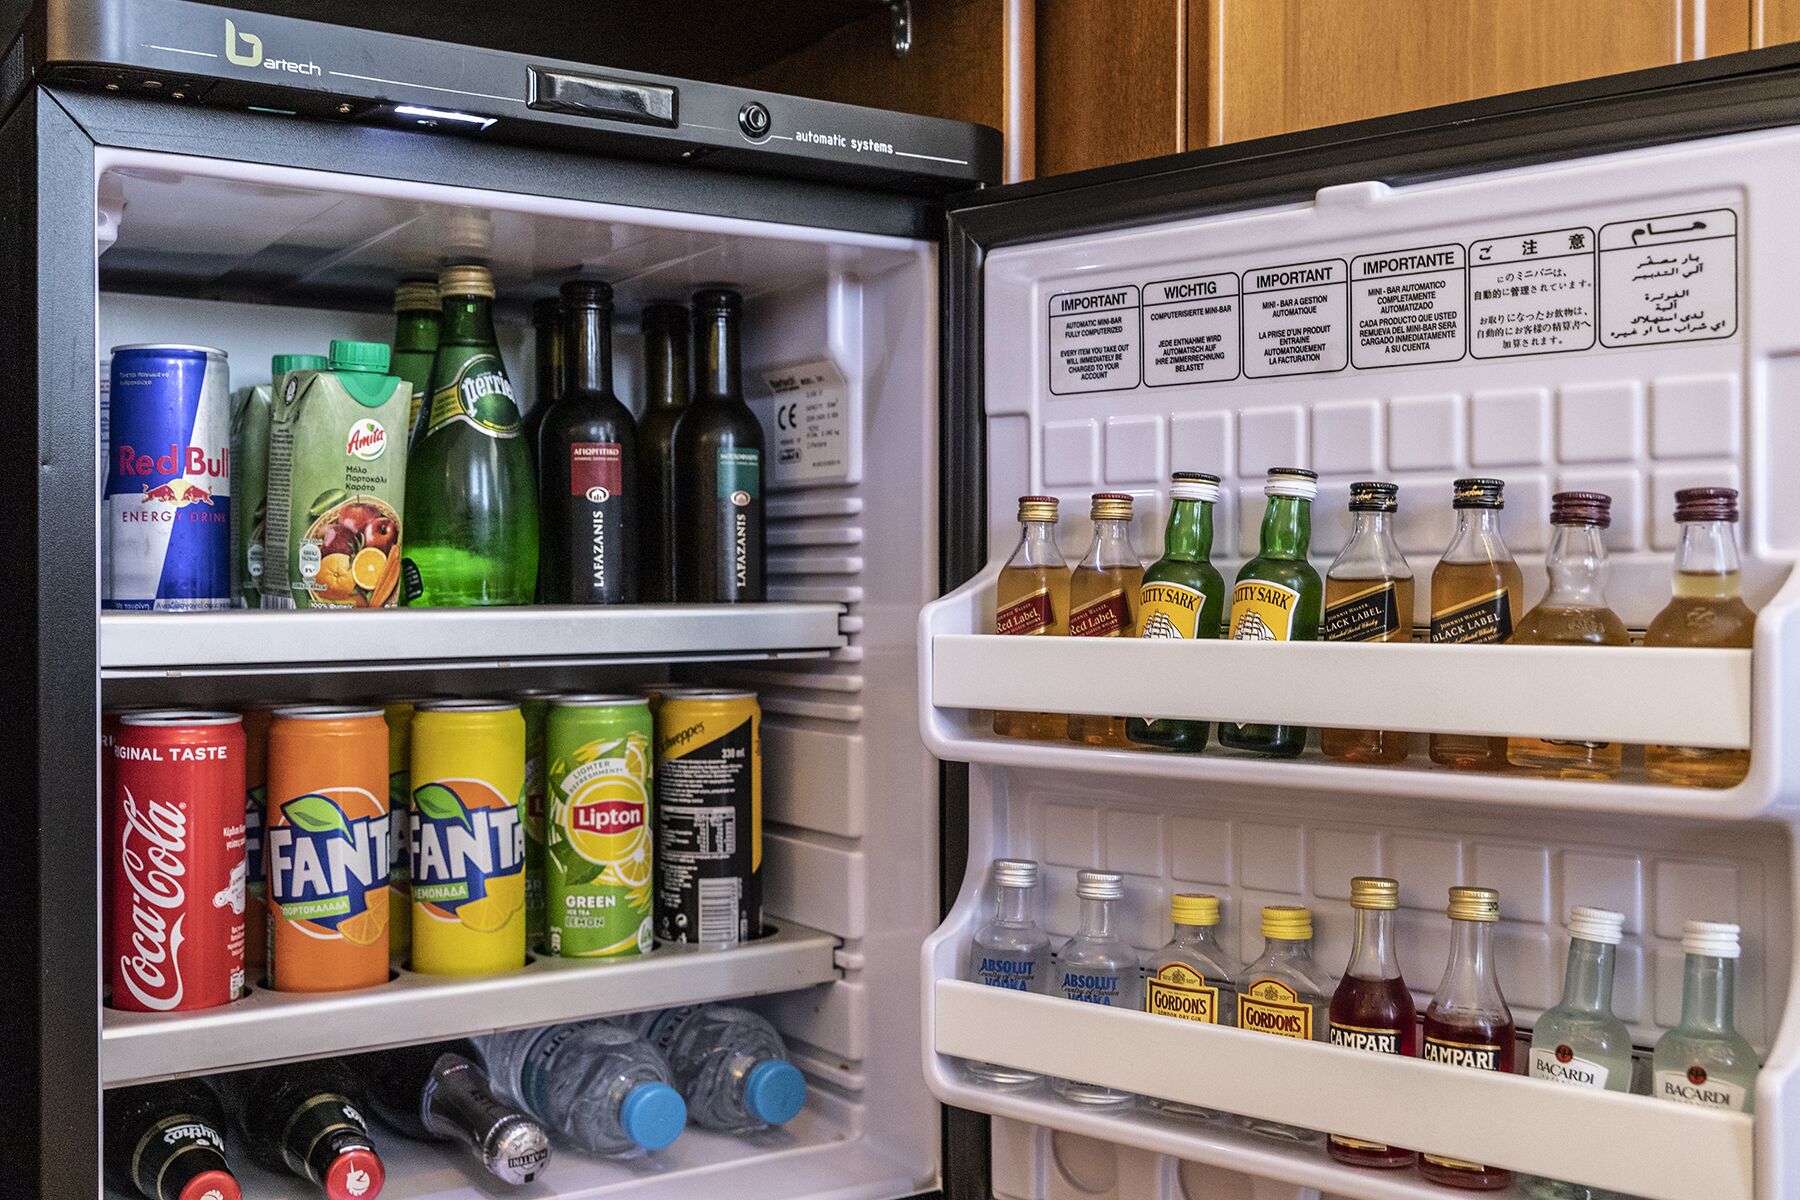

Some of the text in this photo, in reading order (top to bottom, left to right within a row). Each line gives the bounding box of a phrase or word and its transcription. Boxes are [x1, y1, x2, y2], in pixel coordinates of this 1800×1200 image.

[795, 130, 894, 154] automatic systems
[1363, 251, 1455, 275] IMPORTANTE
[1256, 267, 1333, 288] IMPORTANT
[1164, 281, 1217, 299] WICHTIG
[1368, 280, 1446, 296] MINI BAR AUTOMATICO
[1061, 292, 1127, 311] IMPORTANT
[1262, 295, 1328, 309] MINI BAR A GESTION
[1377, 291, 1436, 305] COMPLETAMENTE
[1150, 305, 1232, 321] COMPUTERISIERTE MINI-BAR
[1272, 306, 1317, 318] AUTOMATIQUE
[1380, 301, 1434, 314] AUTOMATIZADO
[1066, 317, 1122, 329] AUTOMATIC MINI-BAR
[1360, 311, 1457, 328] CADA PRODUCTO QUE USTED
[1065, 326, 1123, 338] FULLY COMPUTERIZED
[1268, 329, 1285, 339] PRISE
[1287, 328, 1302, 336] D'UN
[1303, 325, 1331, 335] PRODUIT
[1360, 321, 1457, 337] REMUEVA DEL MINI-BAR SERA
[1158, 334, 1221, 348] JEDE ENTNAHME WIRD
[1280, 336, 1310, 346] ENTRAINE
[1360, 330, 1456, 347] CARGADO INMEDIATAMENTE
[1103, 345, 1117, 353] TAKE
[1163, 344, 1217, 356] AUTOMATISCH AUF
[1264, 343, 1326, 356] AUTOMATIQUEMENT
[1391, 344, 1401, 353] SU
[1402, 342, 1430, 352] CUENTA
[1079, 354, 1114, 364] IMMEDIATELY
[1169, 352, 1225, 364] ZIMMERRECHNUNG
[1269, 353, 1320, 365] LA FACTURATION
[1068, 362, 1119, 373] CHARGED TO YOUR
[1081, 371, 1108, 380] ACCOUNT
[1175, 363, 1204, 372] BELASTET
[461, 371, 518, 418] perrie
[347, 428, 384, 454] Amita
[119, 443, 229, 477] Red Bull
[346, 466, 367, 474] Μήλο
[346, 474, 387, 484] Πορτοκάλι
[346, 483, 375, 491] Καρότο
[122, 511, 183, 522] ENERGY
[593, 510, 604, 588] LAFAZANIS
[736, 513, 747, 587] LAFAZANIS
[1165, 588, 1195, 611] SARK
[1257, 586, 1289, 610] SARK
[996, 619, 1012, 634] Red
[1013, 607, 1038, 626] Label
[1070, 620, 1087, 636] Red
[1088, 608, 1116, 628] Label
[1326, 606, 1382, 632] LACK LABEL
[1432, 625, 1465, 643] BLACK
[1467, 613, 1501, 630] LABEL
[114, 743, 227, 761] IGINAL TASTE
[721, 747, 745, 759] 330 ml
[572, 761, 610, 780] LIGHTER
[579, 808, 641, 830] Lipton
[410, 804, 526, 880] FANTA
[269, 814, 389, 898] FANT
[565, 895, 616, 908] GREEN
[565, 917, 605, 928] LEMON
[979, 958, 1034, 975] ABSOLUT
[985, 977, 1028, 992] VODKA
[1062, 973, 1118, 990] ABSOLUT
[1155, 990, 1207, 1015] GORDON'S
[1157, 1009, 1177, 1018] LONDON
[1246, 1006, 1301, 1033] GORDON'S
[1536, 1058, 1595, 1085] BACARDI
[1664, 1082, 1730, 1106] BACARDI
[164, 1124, 225, 1152] Mythos
[508, 1148, 548, 1168] MARTINI
